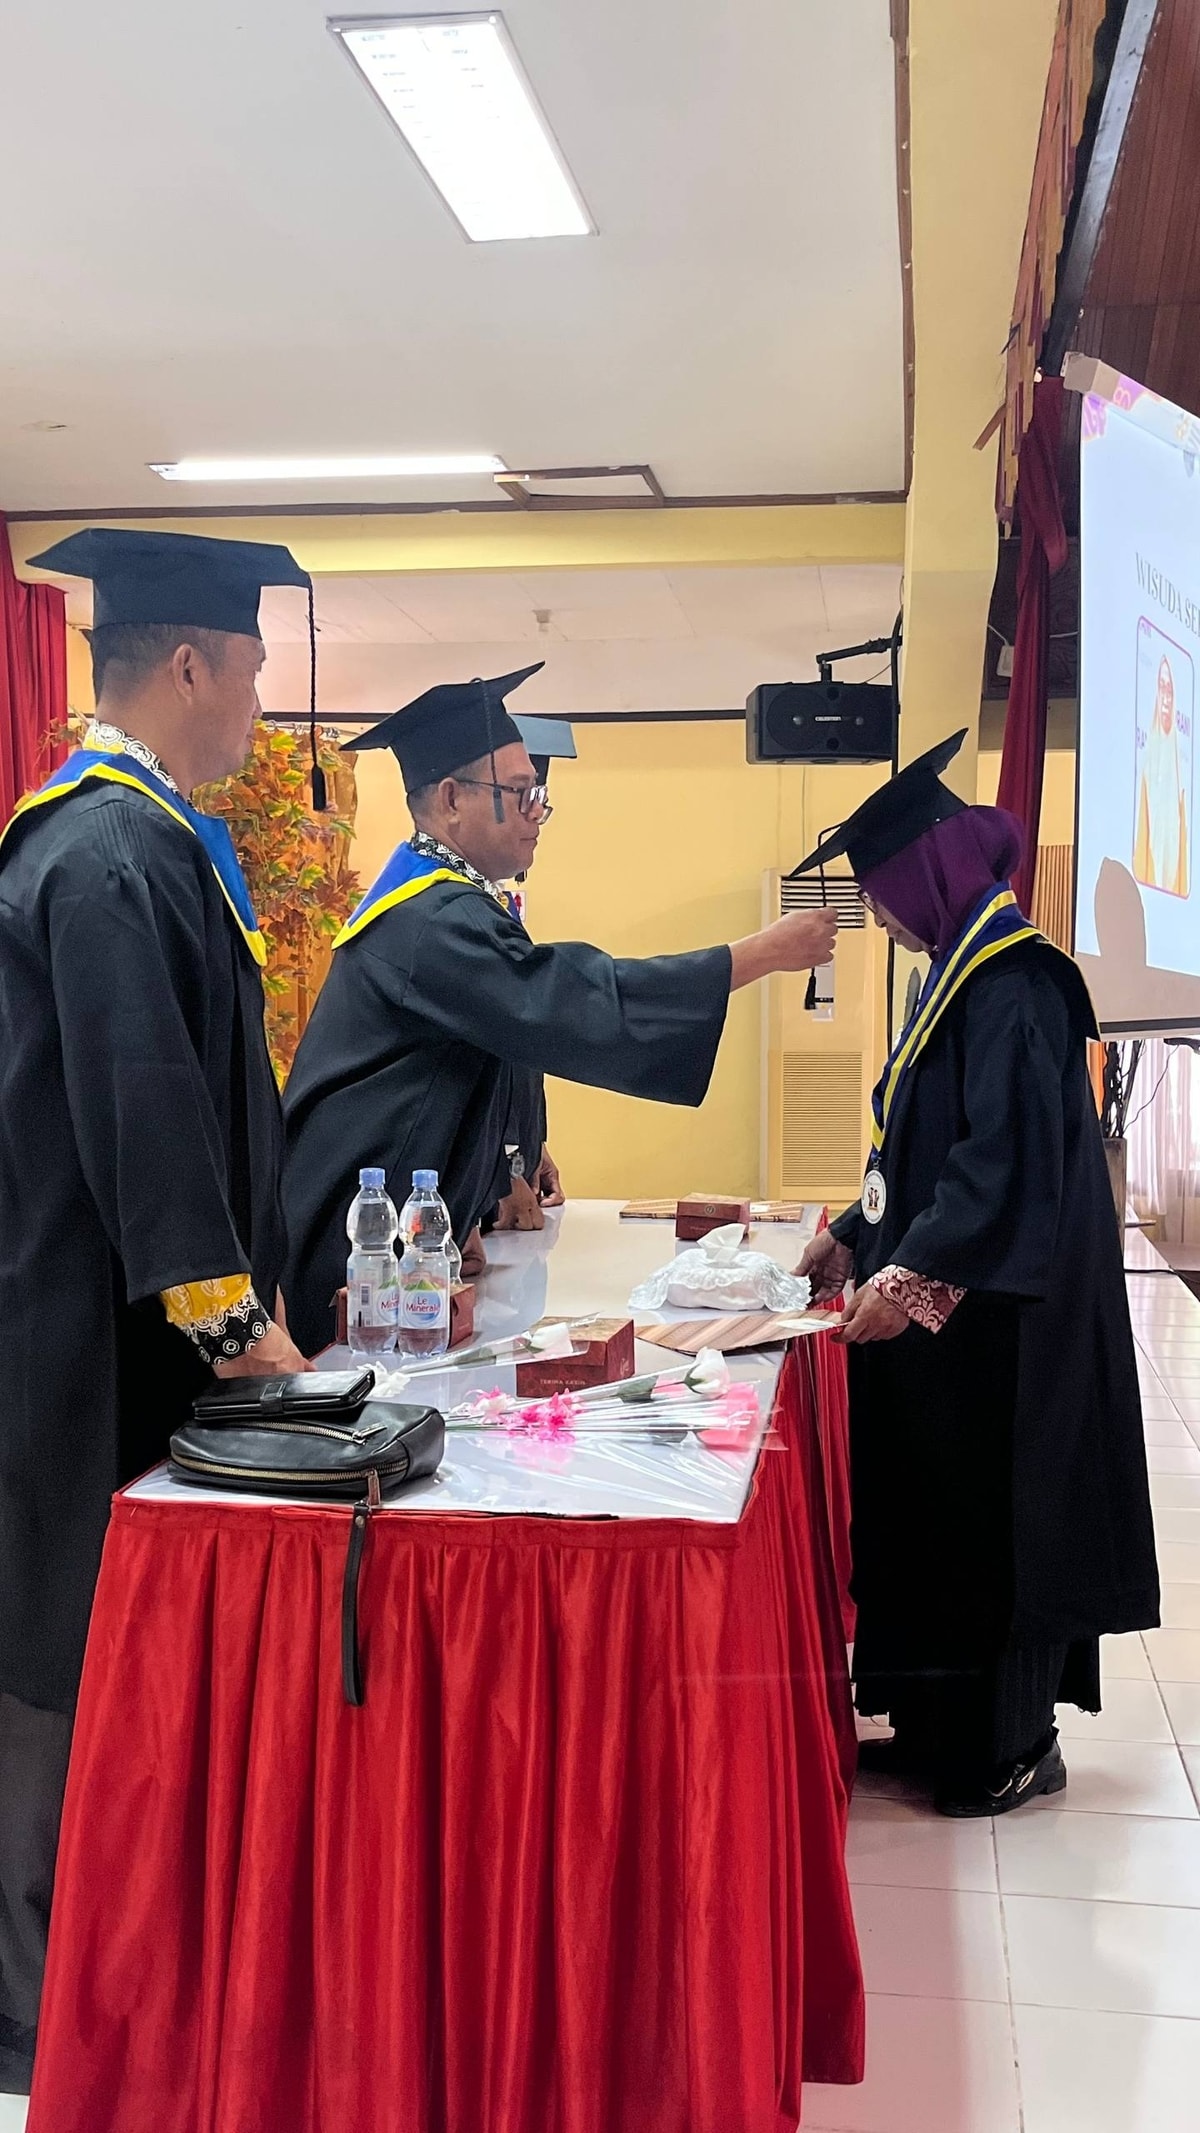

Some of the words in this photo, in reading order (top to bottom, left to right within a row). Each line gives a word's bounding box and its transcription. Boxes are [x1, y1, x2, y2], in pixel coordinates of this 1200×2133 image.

[1135, 551, 1182, 622] WISUDA
[1184, 597, 1200, 637] SE
[417, 1296, 428, 1305] Le
